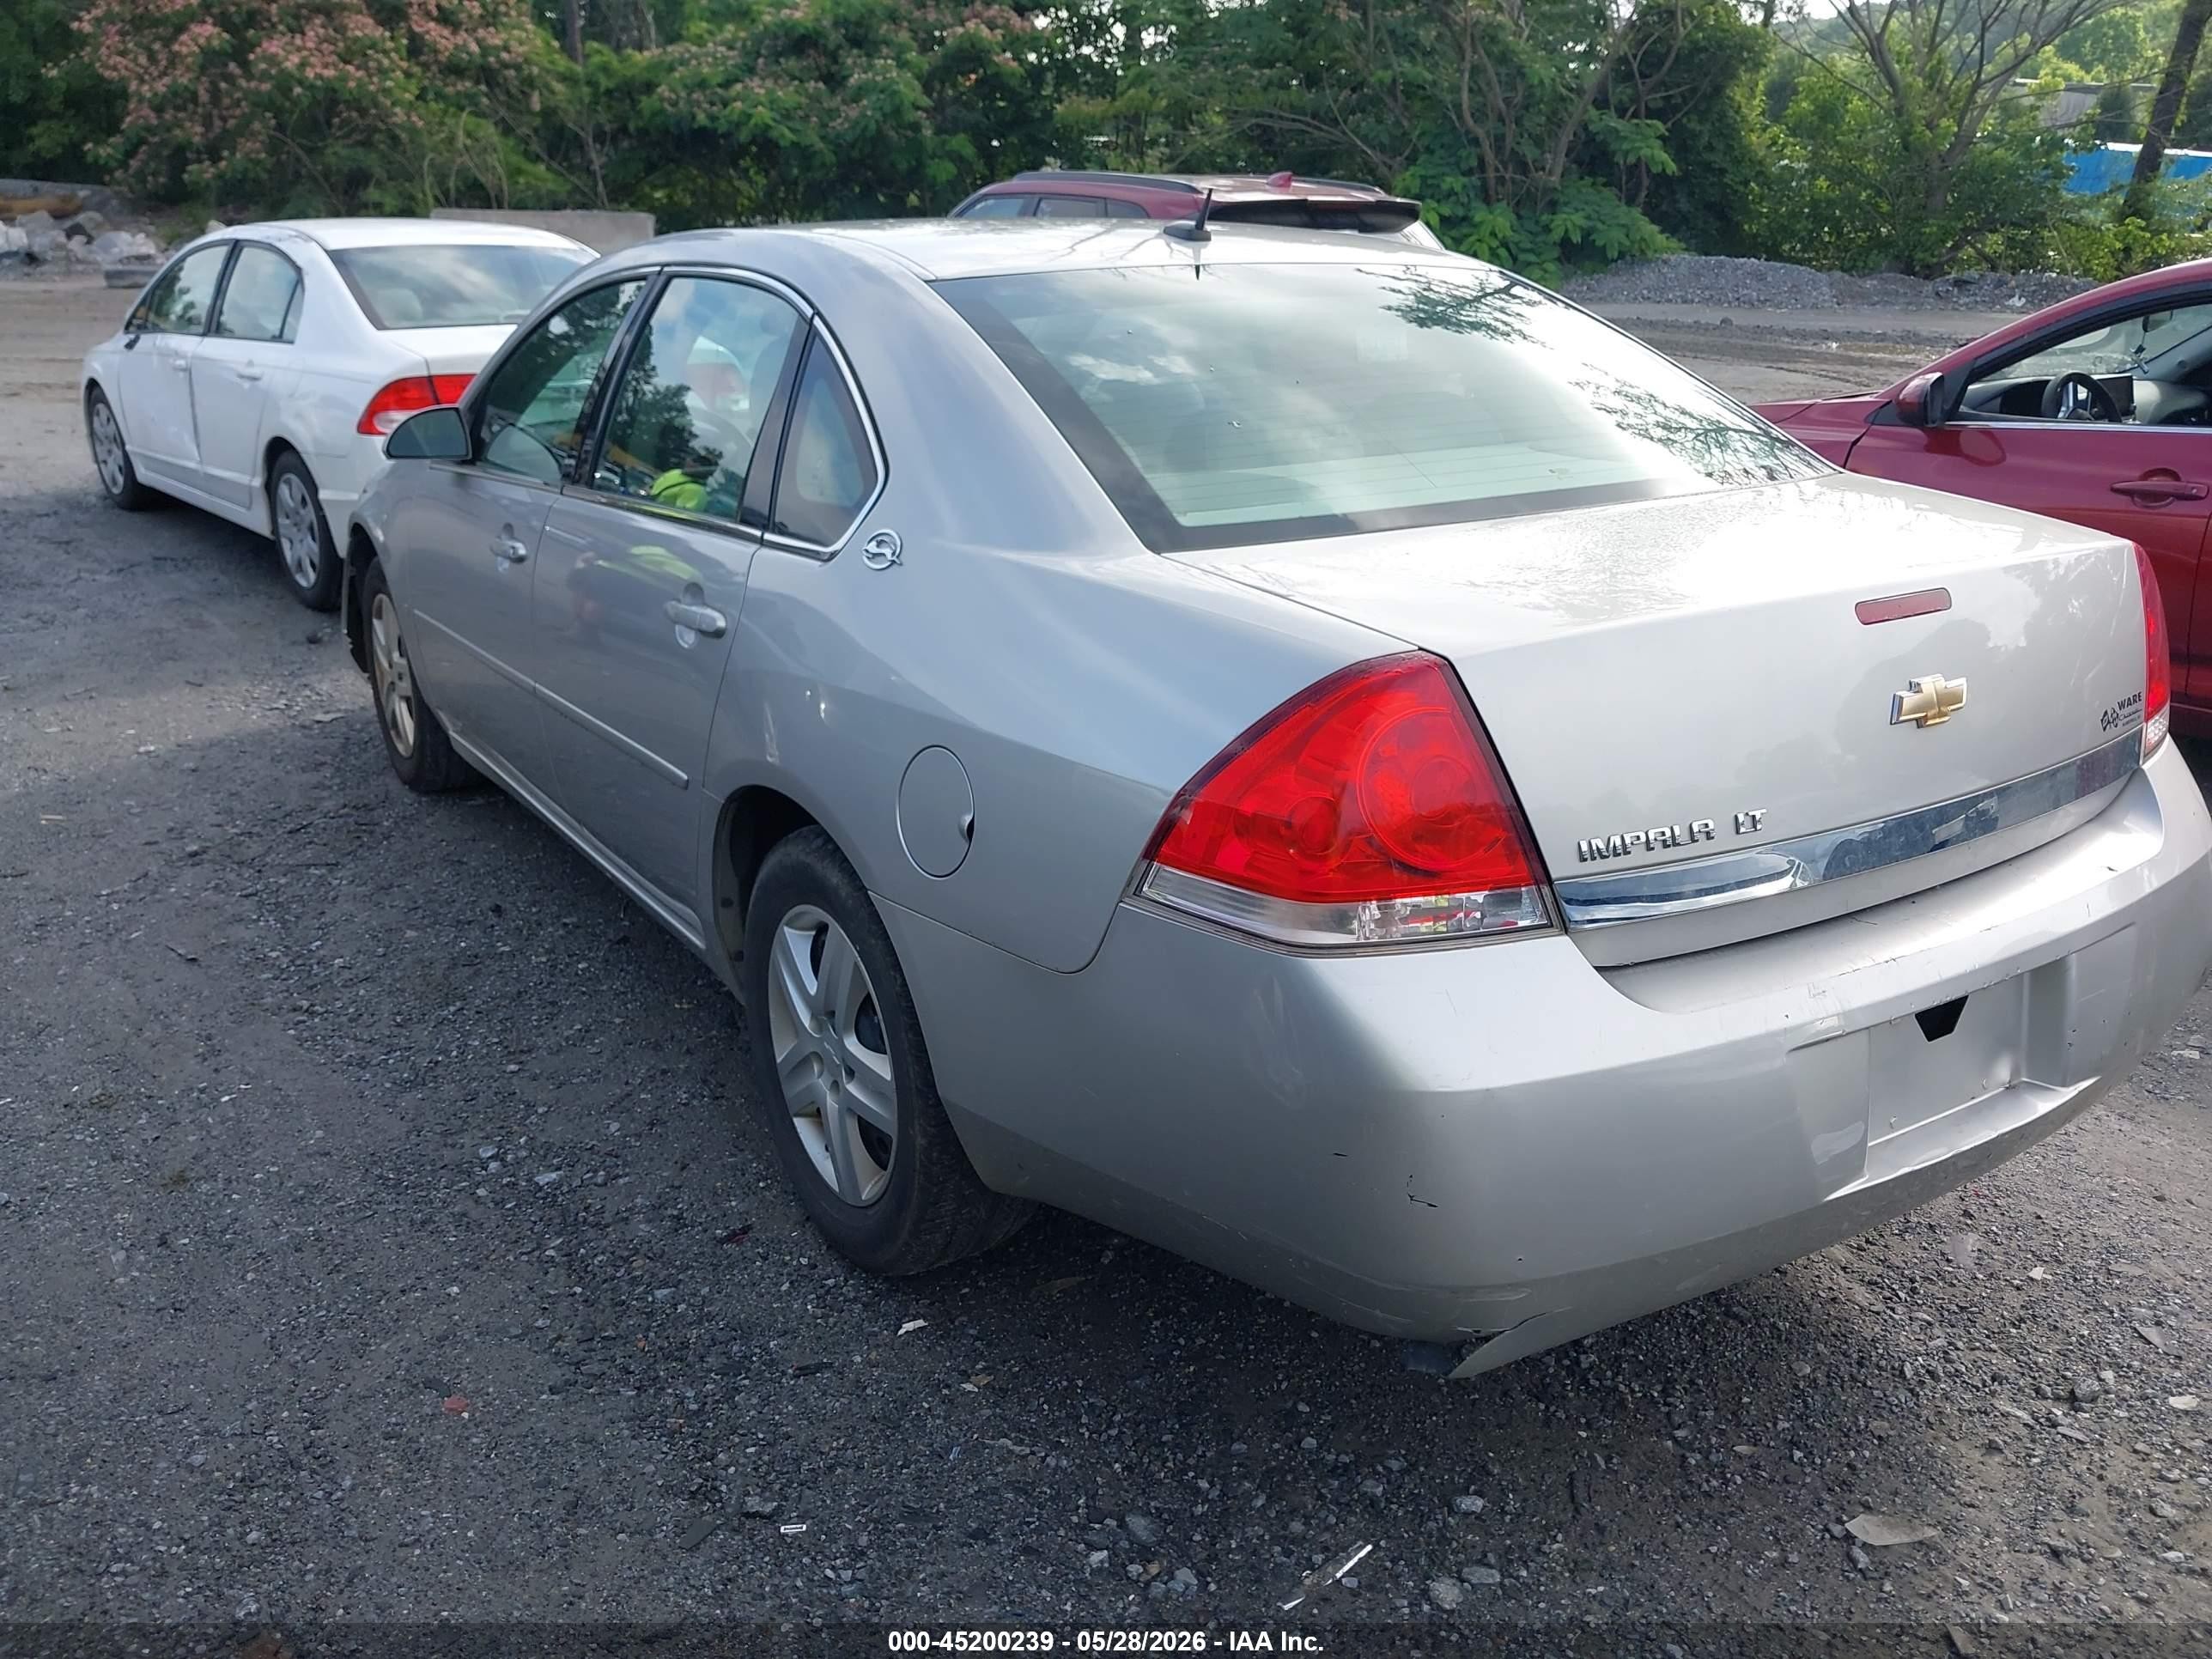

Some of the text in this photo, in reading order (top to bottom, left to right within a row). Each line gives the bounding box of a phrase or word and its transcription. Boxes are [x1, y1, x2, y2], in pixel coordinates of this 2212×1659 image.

[2117, 691, 2142, 711] WARE
[1577, 808, 1767, 862] IMPALA LT
